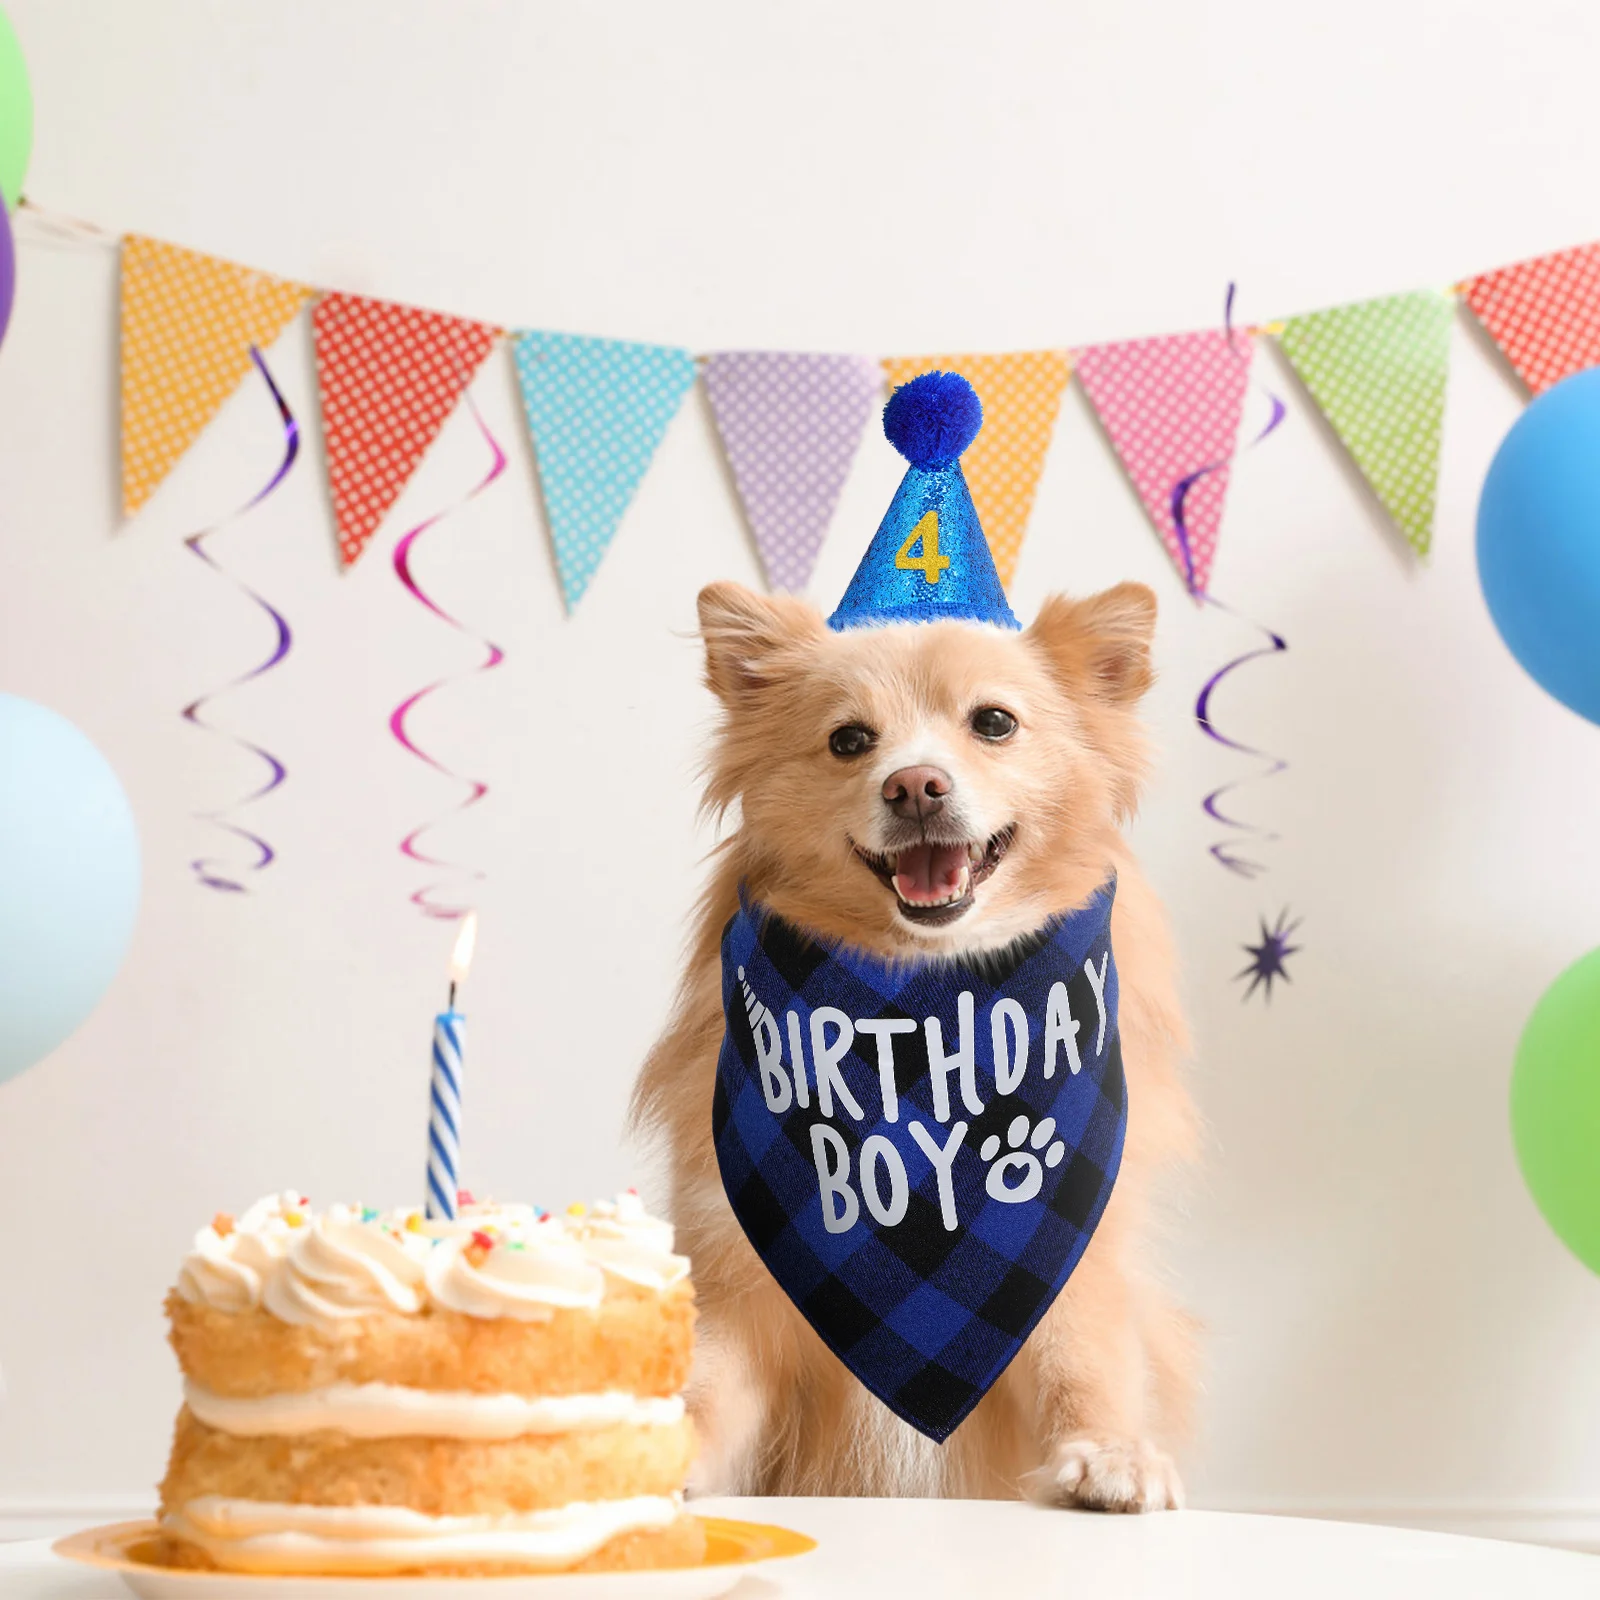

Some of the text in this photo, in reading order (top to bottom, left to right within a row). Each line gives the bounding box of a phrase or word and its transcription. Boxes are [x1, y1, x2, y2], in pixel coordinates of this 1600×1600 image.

[895, 510, 950, 584] 4
[752, 951, 1109, 1124] BIRTHDAY
[809, 1120, 968, 1234] BOY
